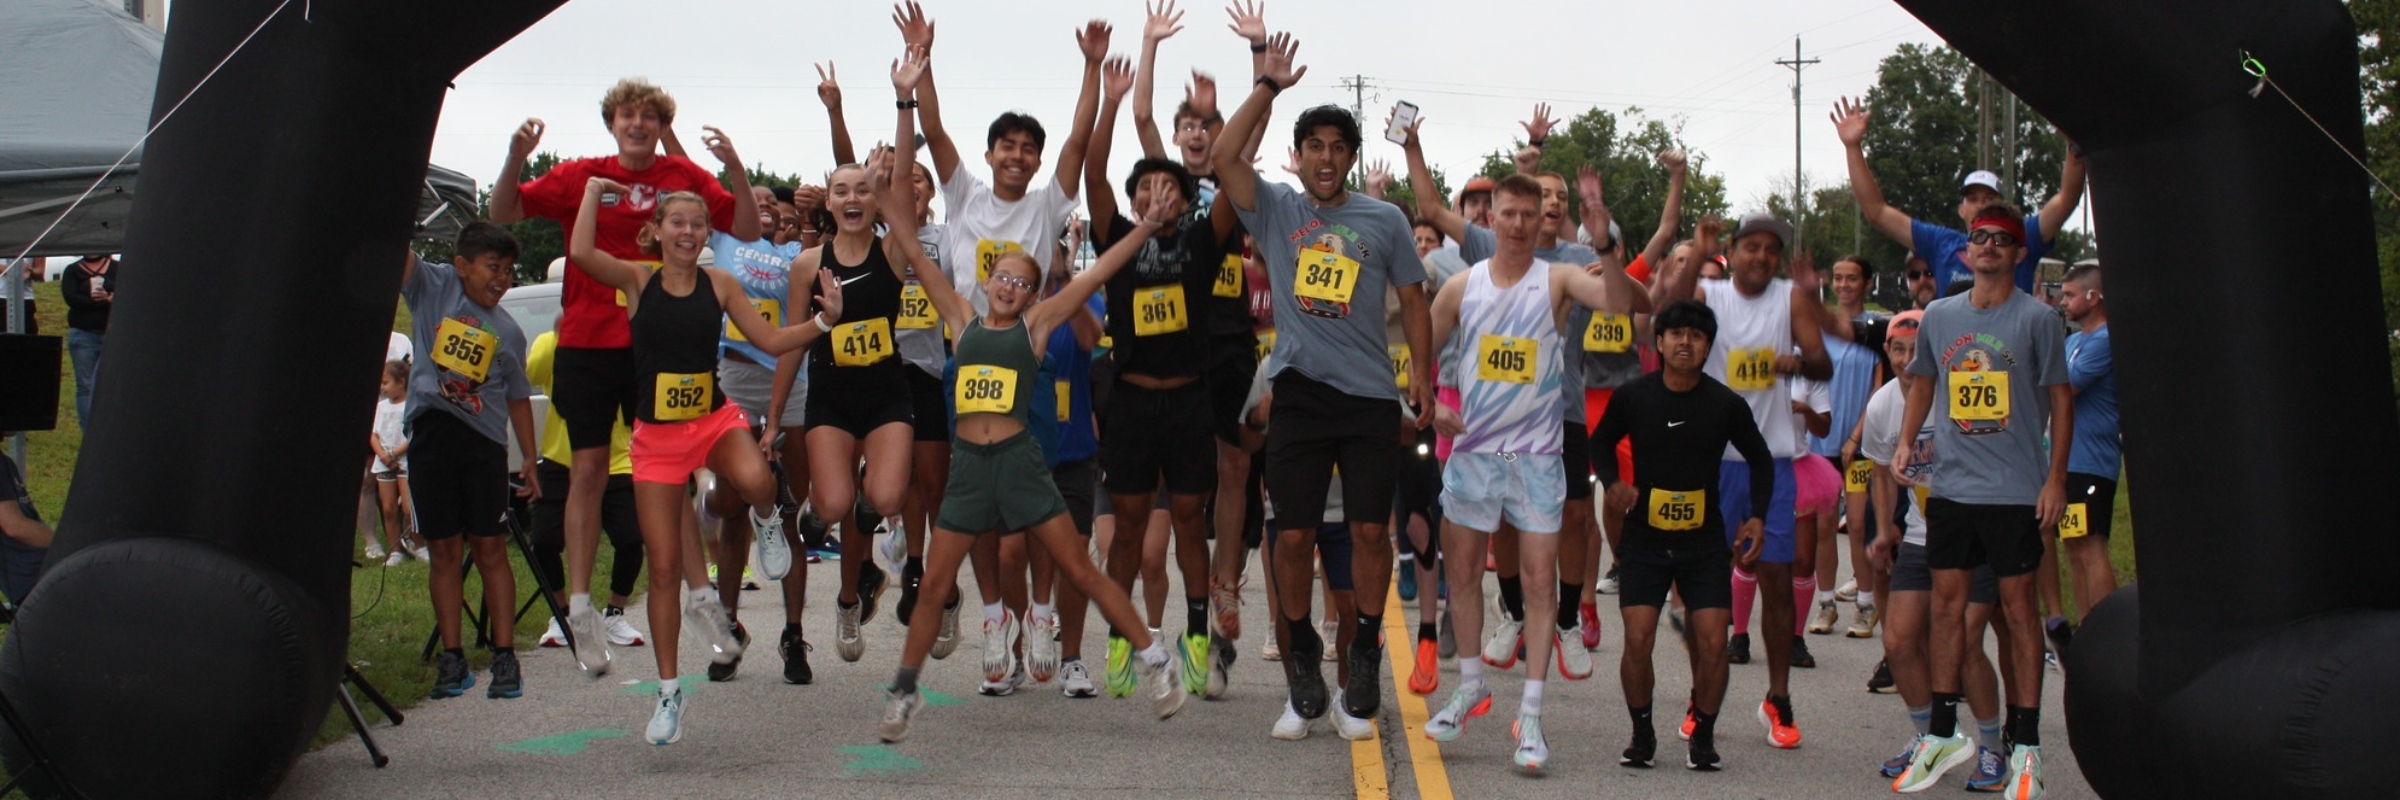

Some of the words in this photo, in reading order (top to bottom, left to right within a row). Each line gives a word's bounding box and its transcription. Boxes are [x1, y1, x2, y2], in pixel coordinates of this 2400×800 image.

[735, 246, 791, 272] CENTRA
[1357, 241, 1371, 259] 5K
[1217, 266, 1236, 287] 45
[1305, 263, 1343, 290] 341
[1142, 300, 1176, 323] 361
[1592, 323, 1624, 342] 339
[443, 333, 486, 367] 355
[843, 332, 881, 357] 414
[1940, 332, 1973, 367] MELON
[2000, 349, 2017, 367] 5K
[1488, 349, 1526, 372] 405
[666, 386, 704, 408] 352
[965, 378, 1004, 400] 398
[1959, 384, 1998, 408] 376
[1658, 502, 1695, 520] 455
